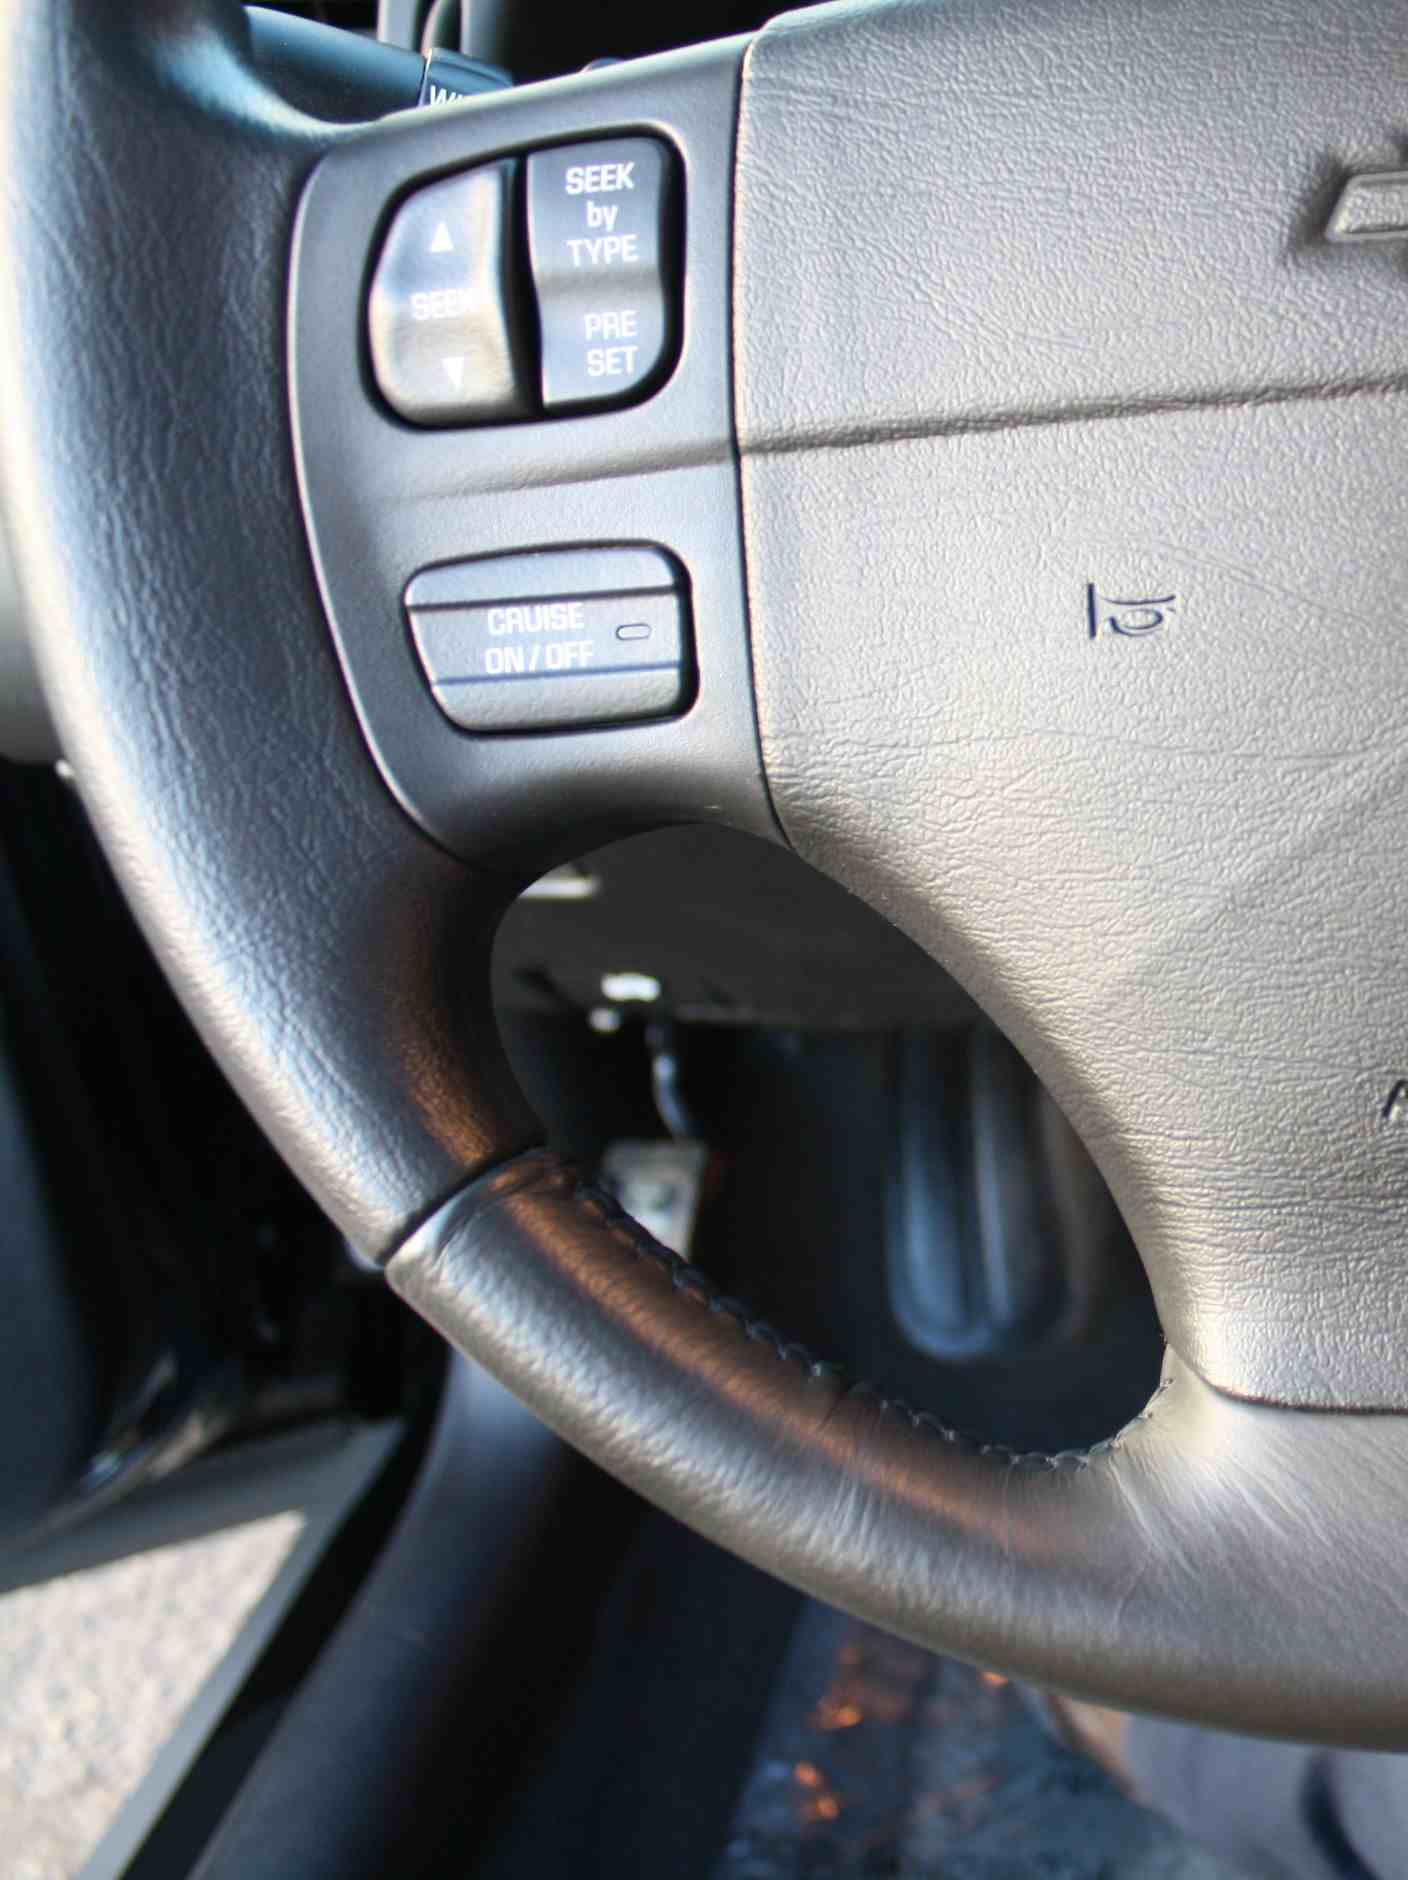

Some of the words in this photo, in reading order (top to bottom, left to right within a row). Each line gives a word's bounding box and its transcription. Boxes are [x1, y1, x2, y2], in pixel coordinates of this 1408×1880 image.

[565, 162, 635, 194] SEEK
[587, 201, 618, 231] by
[567, 234, 639, 267] TYPE
[585, 310, 638, 341] PRE
[587, 346, 638, 376] SET
[487, 602, 586, 636] CRUISE
